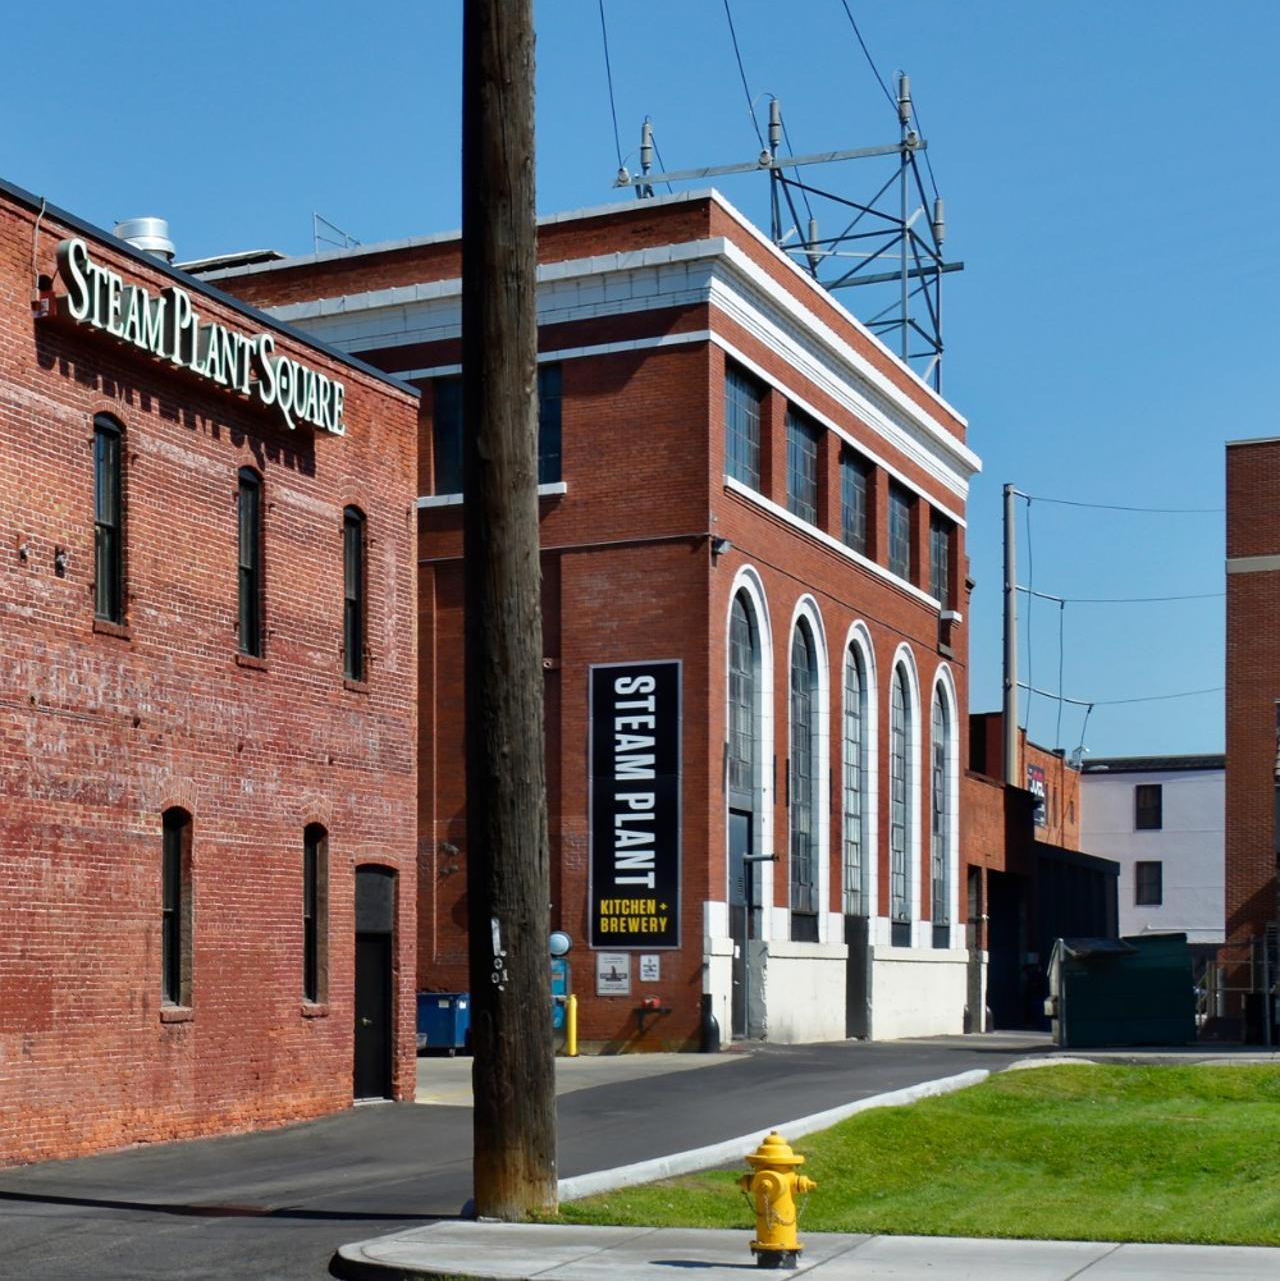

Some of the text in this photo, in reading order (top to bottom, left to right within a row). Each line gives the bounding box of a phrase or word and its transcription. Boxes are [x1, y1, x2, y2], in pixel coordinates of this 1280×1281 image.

[65, 238, 346, 437] STEAM PLANT SQUARE
[614, 675, 656, 889] STEAM PLANT
[600, 899, 656, 915] KITCHEN
[600, 917, 668, 933] BREWERY
